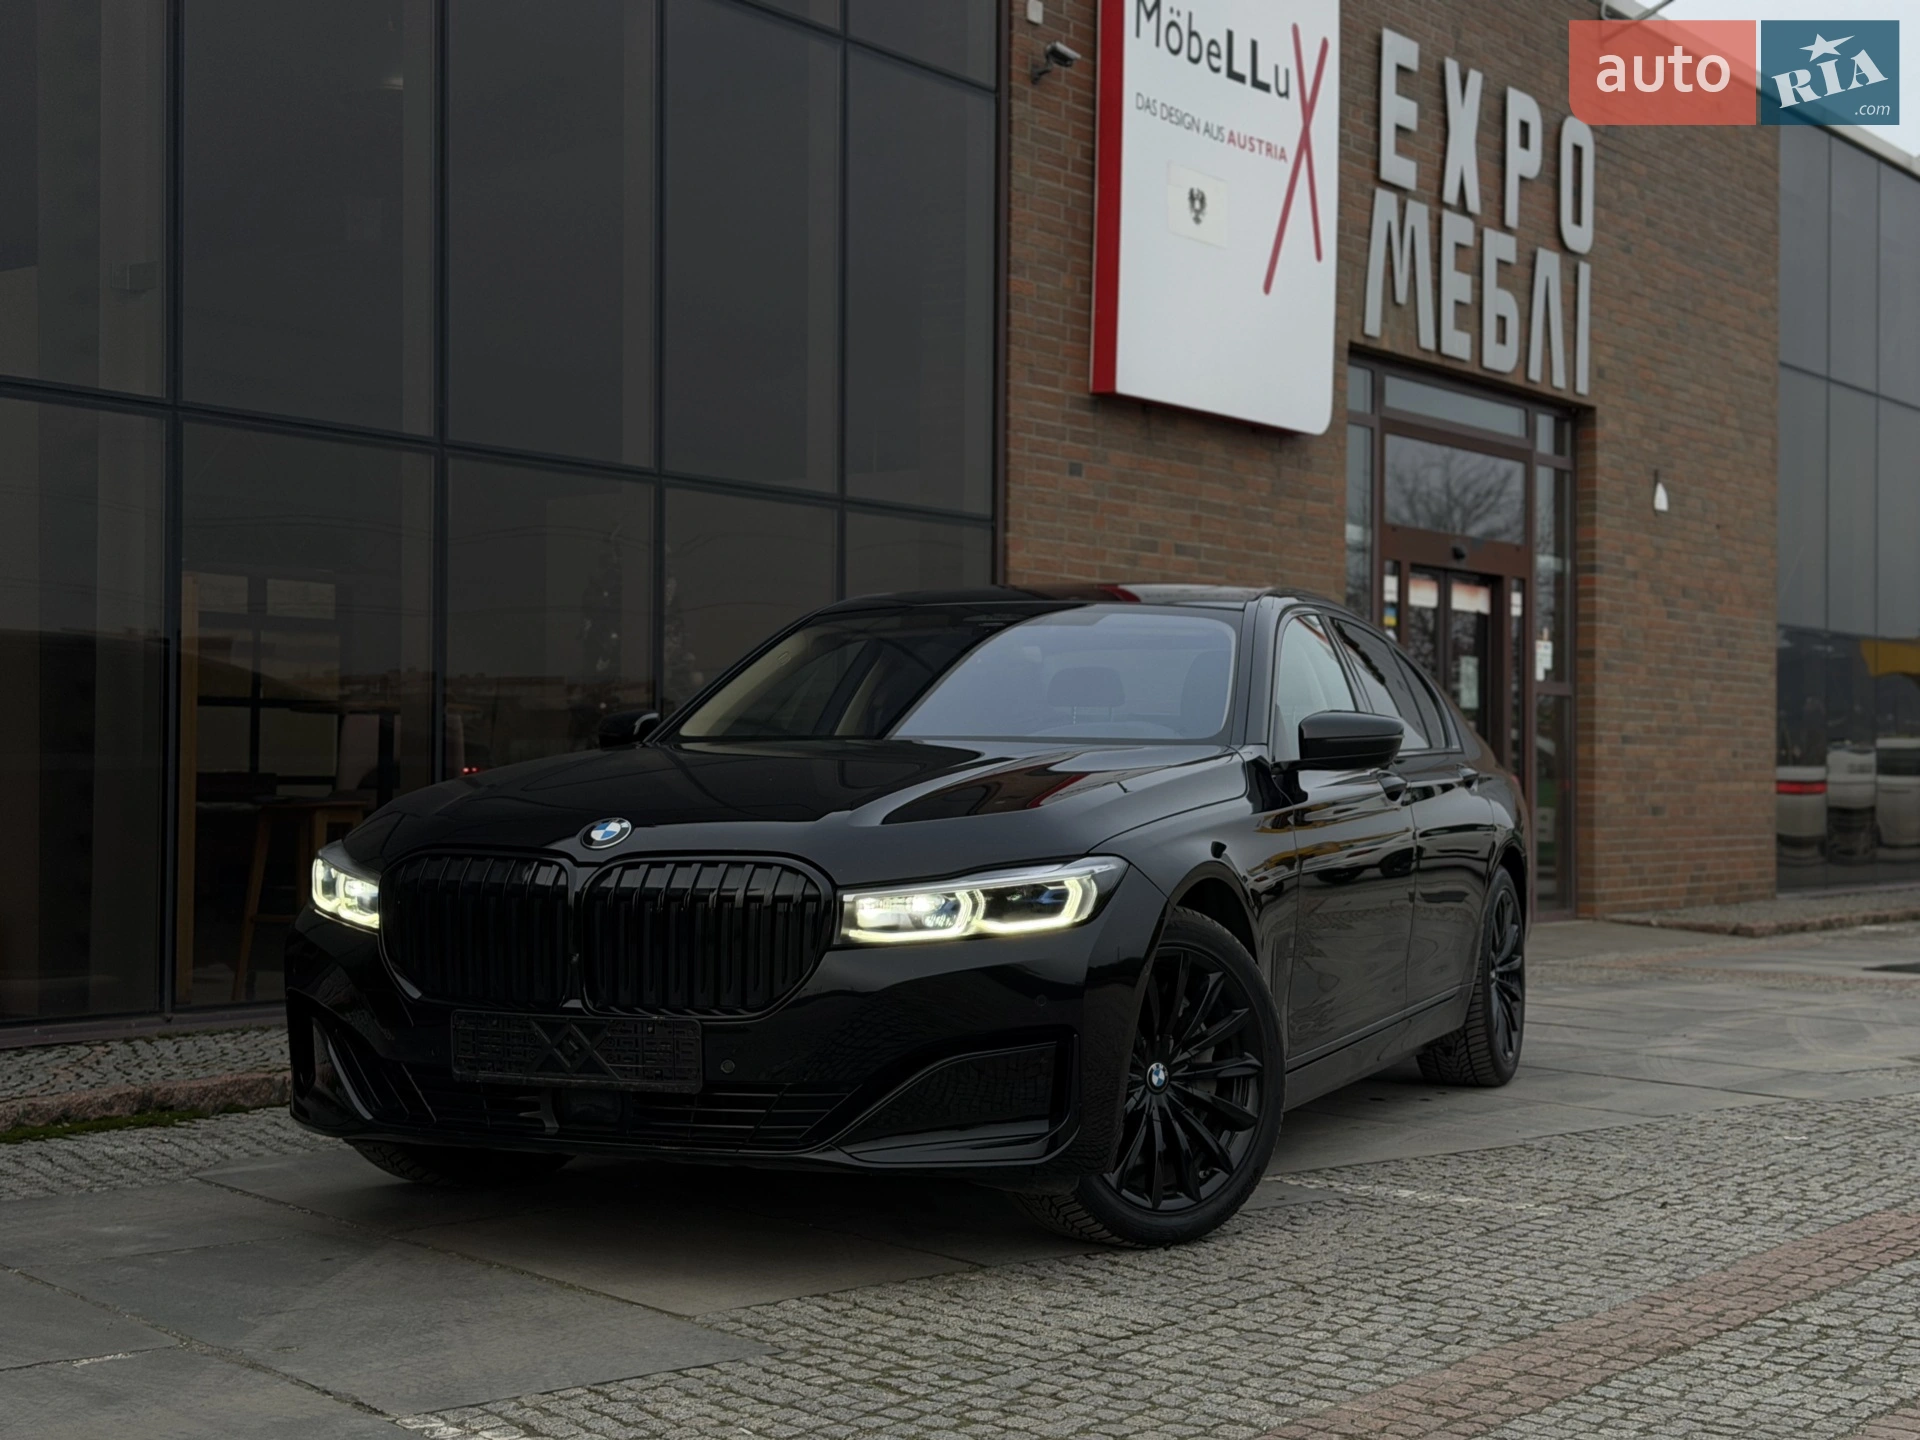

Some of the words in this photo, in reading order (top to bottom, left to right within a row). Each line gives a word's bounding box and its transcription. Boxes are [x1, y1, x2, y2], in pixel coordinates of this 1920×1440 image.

[1135, 92, 1157, 116] DAS
[1160, 103, 1200, 134] DESIGN
[1202, 121, 1225, 143] AUS
[1227, 130, 1287, 162] AUSTRIA
[1379, 28, 1594, 254] EXPO
[1363, 187, 1591, 396] МЕБЛІ
